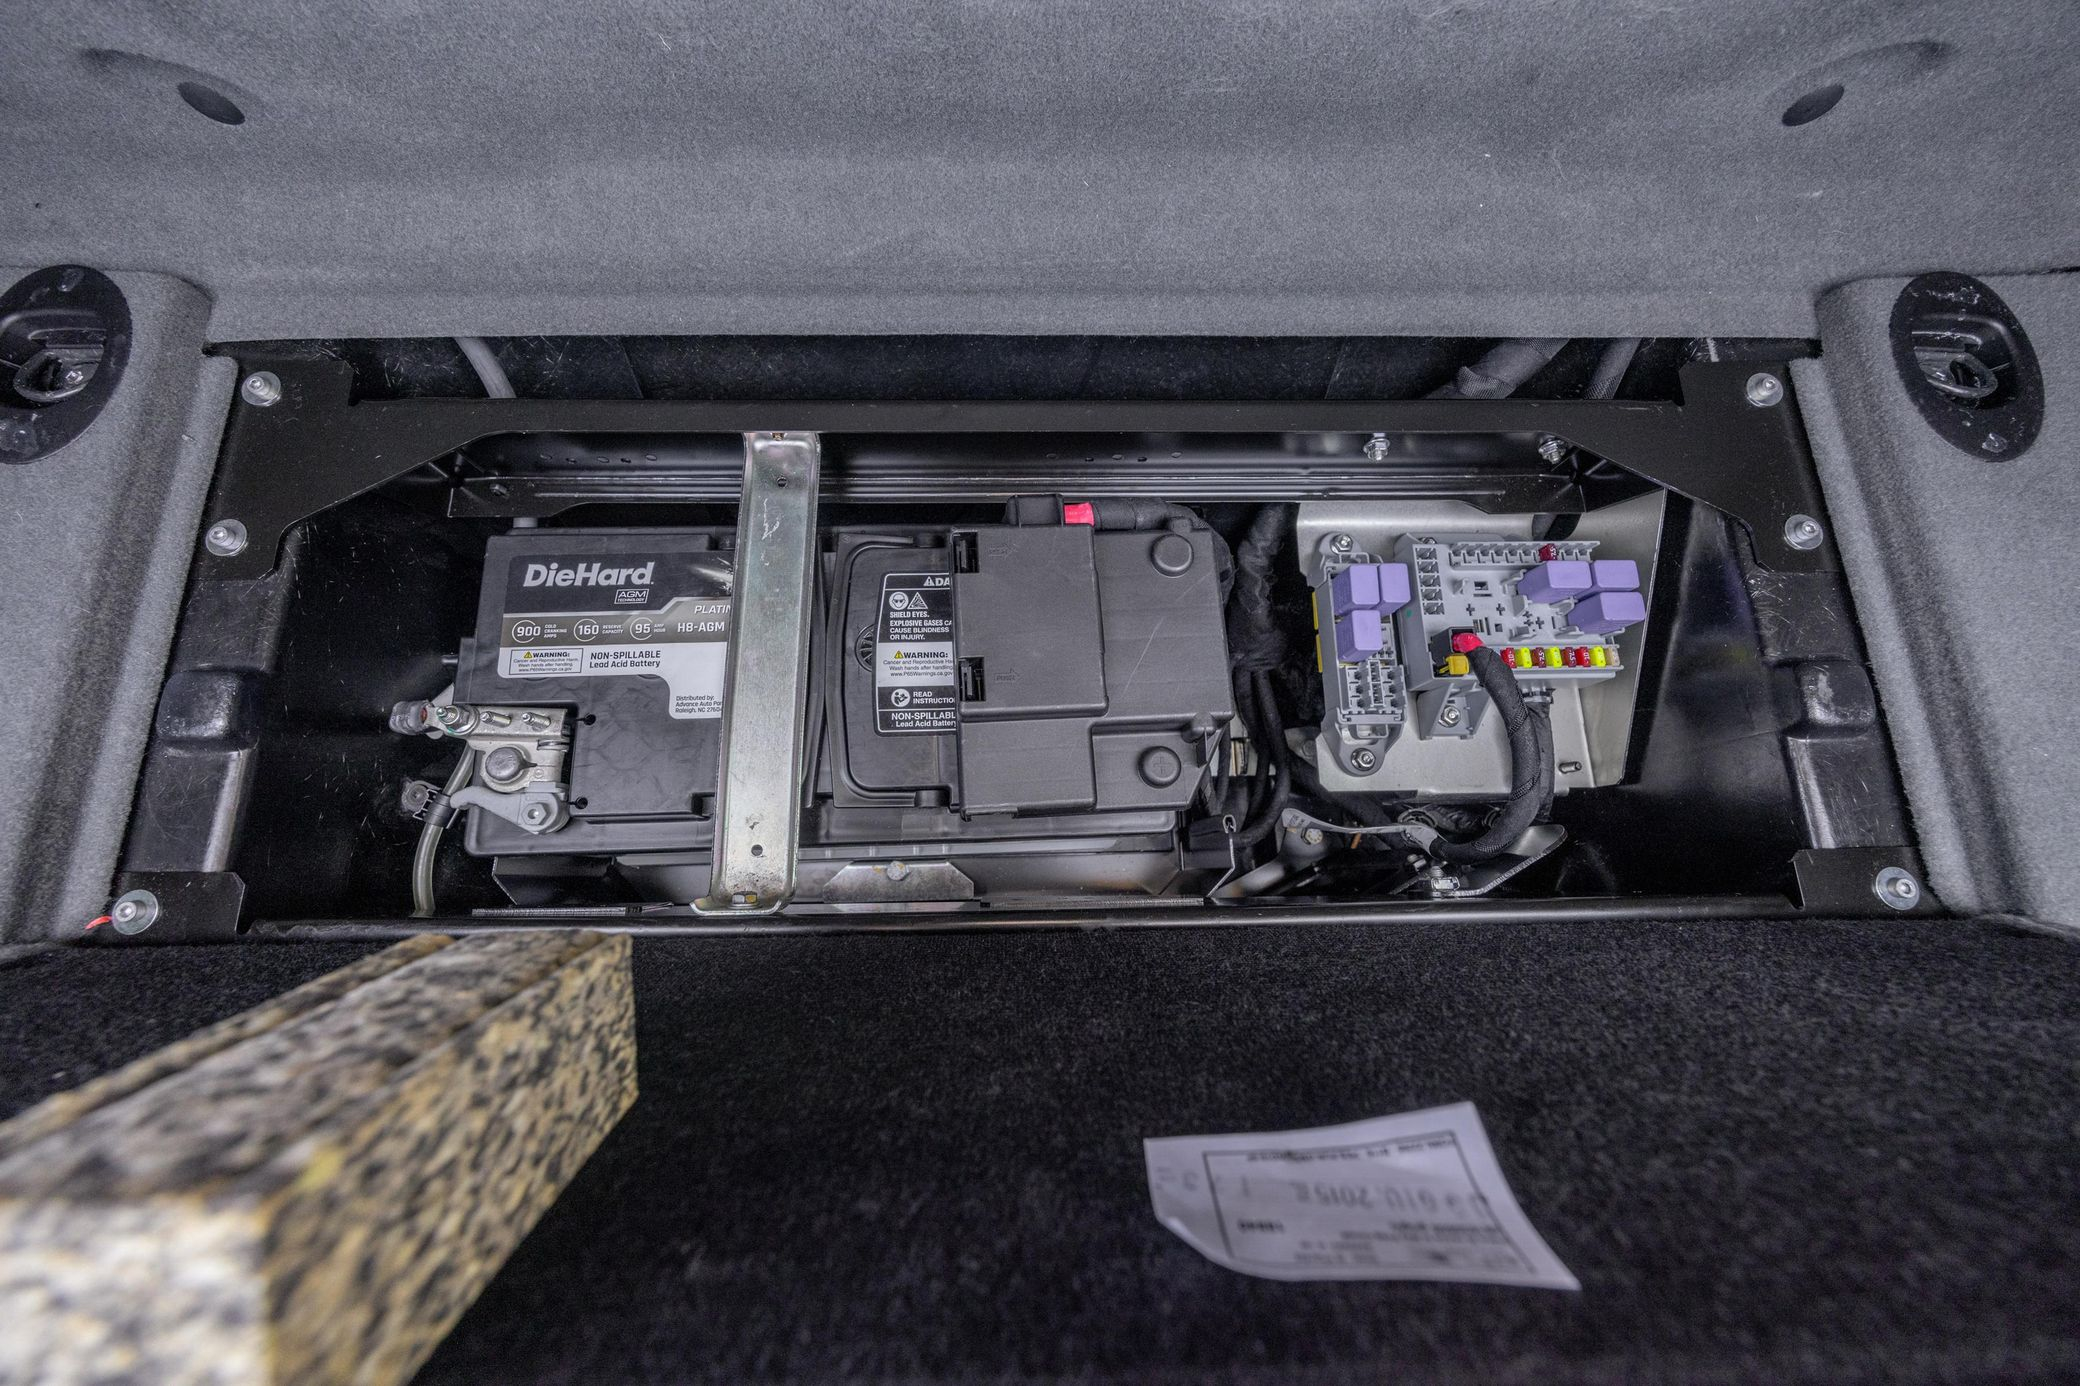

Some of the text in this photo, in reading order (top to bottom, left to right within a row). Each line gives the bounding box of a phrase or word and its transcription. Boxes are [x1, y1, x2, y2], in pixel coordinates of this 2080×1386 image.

[618, 590, 647, 598] AGM
[516, 626, 541, 637] 900
[578, 624, 599, 635] 160
[635, 623, 651, 634] 95
[677, 621, 725, 633] H8-AGM
[590, 651, 661, 660] NON-SPILLABLE
[589, 659, 660, 668] Lead Acid Battery
